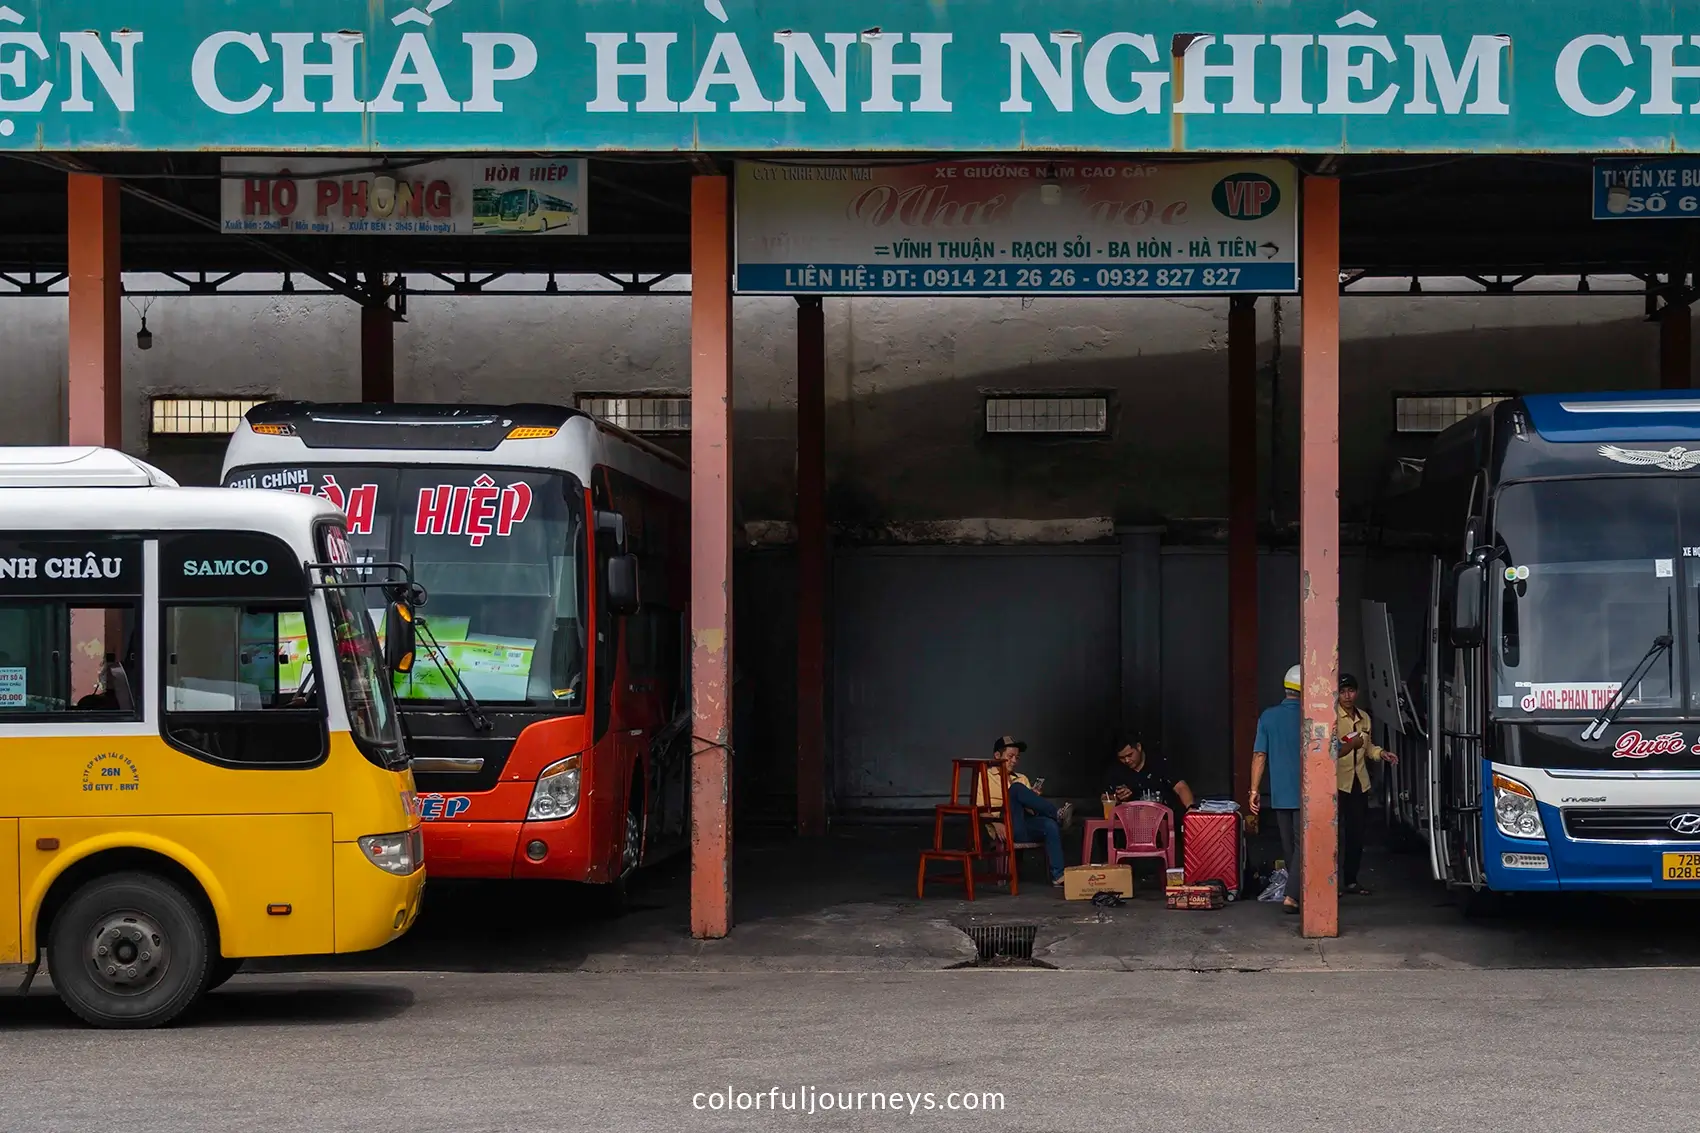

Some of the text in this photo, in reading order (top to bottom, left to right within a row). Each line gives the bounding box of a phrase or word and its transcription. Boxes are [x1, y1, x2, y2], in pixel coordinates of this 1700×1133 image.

[191, 0, 538, 114] CHẤP
[585, 0, 952, 112] HÀNH
[1001, 9, 1510, 116] NGHIÊM
[1555, 34, 1700, 117] CH
[935, 167, 957, 178] XE
[964, 163, 1029, 178] GIƯỜNG
[1081, 166, 1115, 178] CAO
[1121, 163, 1158, 178] CẤP
[1657, 169, 1676, 187] XE
[1225, 181, 1272, 216] VIP
[1626, 190, 1671, 212] SỐ
[892, 238, 929, 258] VĨNH
[938, 237, 994, 261] THUẬN
[1012, 241, 1057, 261] RẠCH
[1063, 235, 1091, 258] SỎI
[1109, 241, 1131, 258] BA
[1137, 237, 1172, 258] HÒN
[1189, 236, 1211, 257] HÀ
[1218, 236, 1257, 257] TIÊN
[785, 264, 833, 286] LIÊN
[923, 269, 976, 287] 0914
[982, 269, 1009, 287] 21
[1016, 269, 1042, 287] 26
[1049, 269, 1076, 287] 26
[1096, 269, 1149, 287] 0932
[1155, 268, 1195, 286] 827
[1202, 268, 1242, 286] 827
[262, 469, 309, 488] CHÍNH
[414, 473, 533, 547] HIỆP
[1682, 546, 1692, 557] XE
[45, 551, 122, 579] CHÂU
[183, 559, 269, 576] SAMCO
[1523, 698, 1536, 709] 01
[1612, 730, 1687, 759] Quốc
[102, 768, 120, 776] 26N
